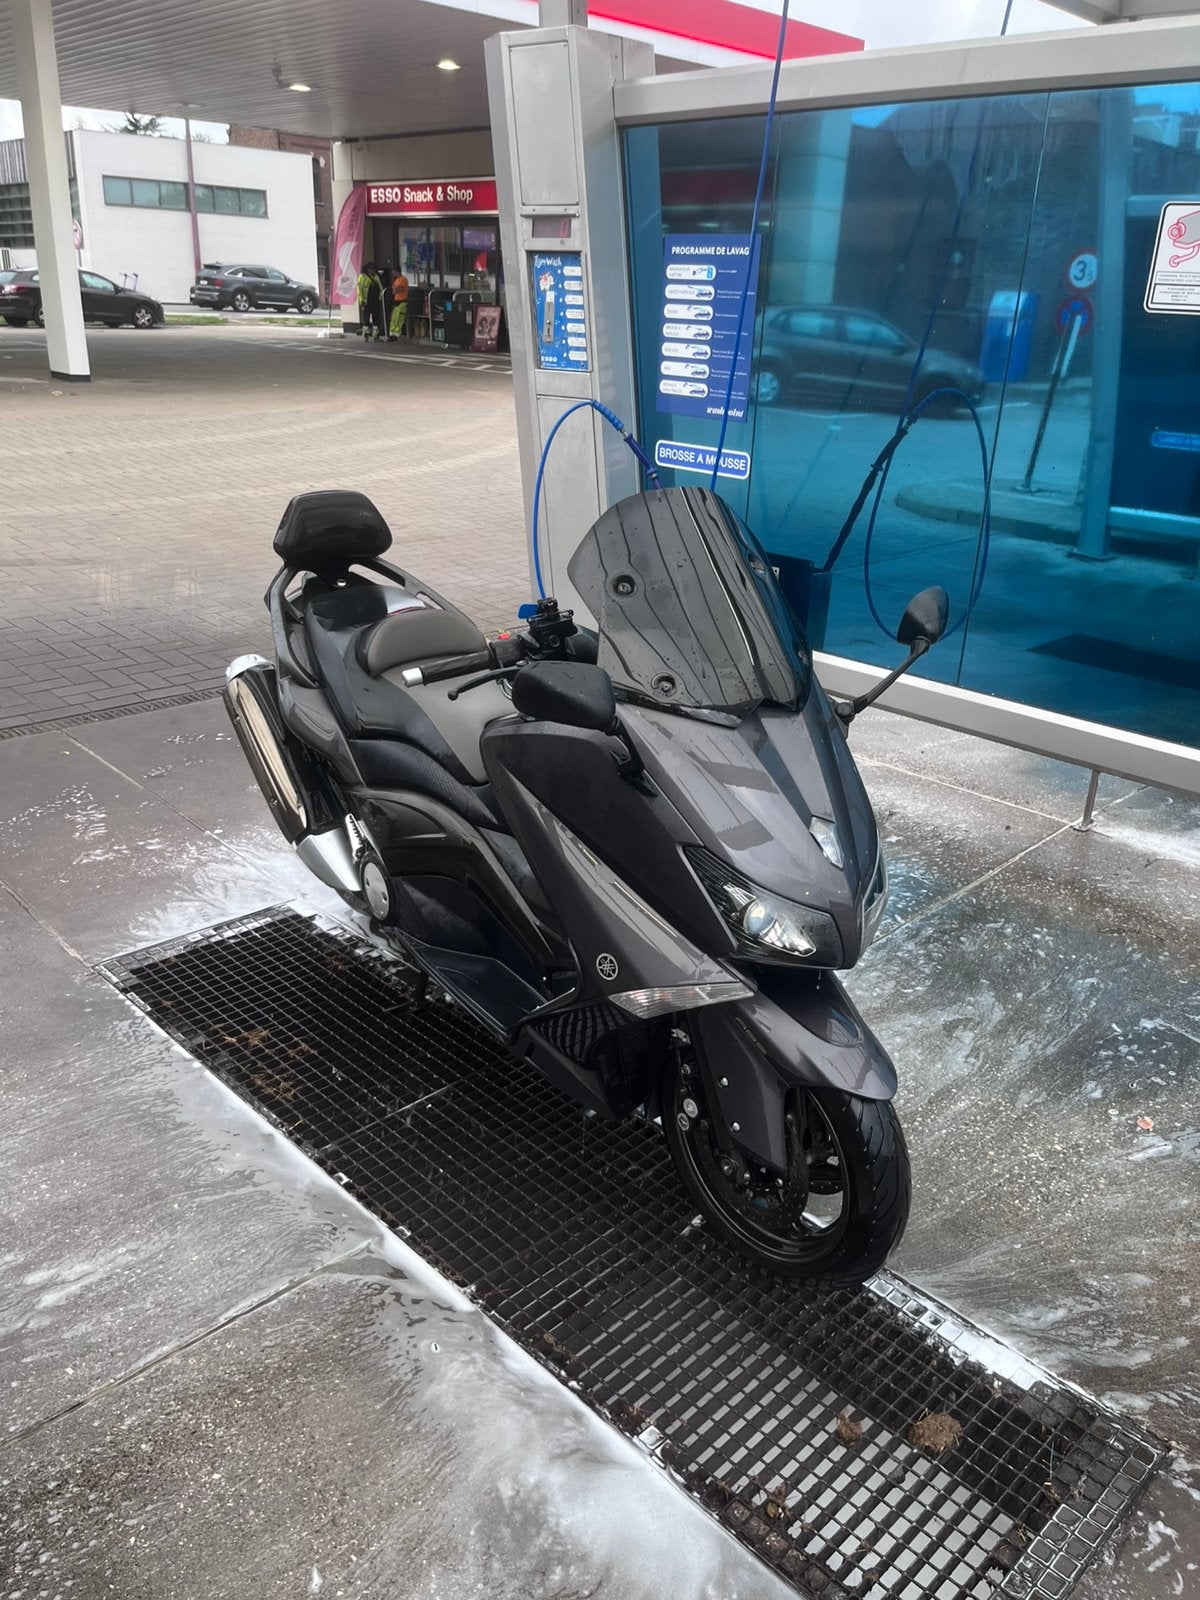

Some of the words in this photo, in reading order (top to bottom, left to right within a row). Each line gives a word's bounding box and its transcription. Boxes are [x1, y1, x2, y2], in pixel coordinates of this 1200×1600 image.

[370, 187, 401, 203] ESSO
[404, 187, 433, 203] Snack
[436, 186, 444, 200] &
[446, 185, 473, 204] Shop
[671, 246, 716, 256] PROGRAMME
[716, 247, 725, 256] DE
[726, 247, 750, 256] LAVAG
[706, 406, 744, 418] washoint
[659, 447, 696, 463] BROSSE
[696, 453, 704, 465] A
